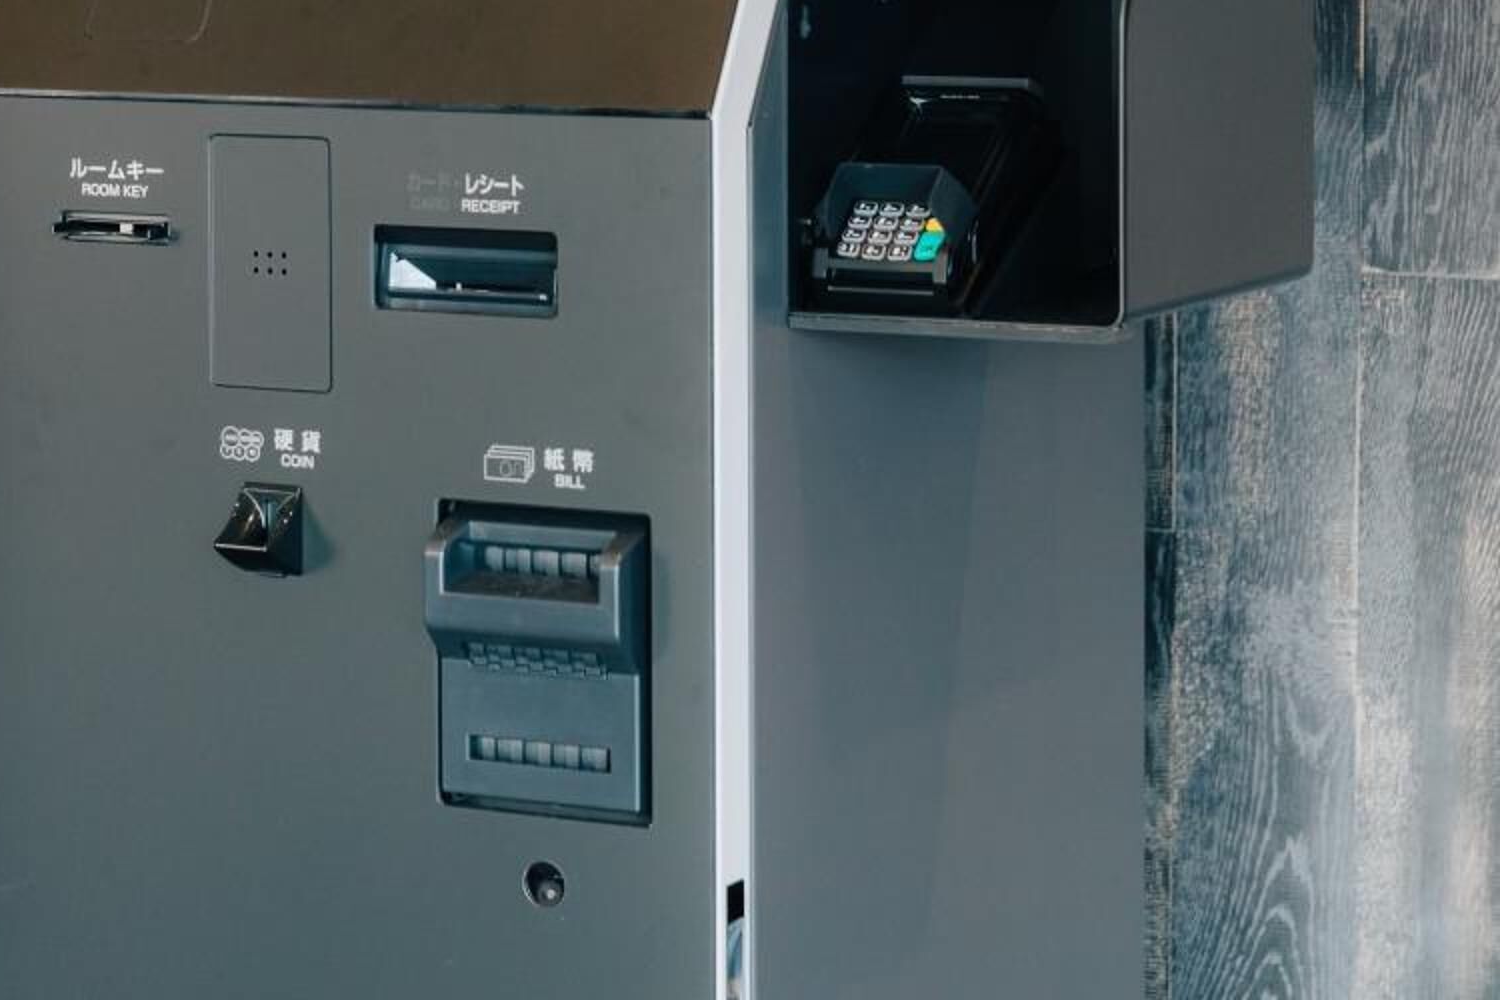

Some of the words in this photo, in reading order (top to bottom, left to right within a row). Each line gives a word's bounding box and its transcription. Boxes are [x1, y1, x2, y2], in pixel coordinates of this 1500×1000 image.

[69, 156, 165, 180] ルームキー
[81, 183, 121, 197] ROOM
[122, 185, 149, 199] KEY
[460, 198, 520, 214] RECEIPT
[280, 454, 315, 469] COIN
[554, 473, 586, 489] BILL
